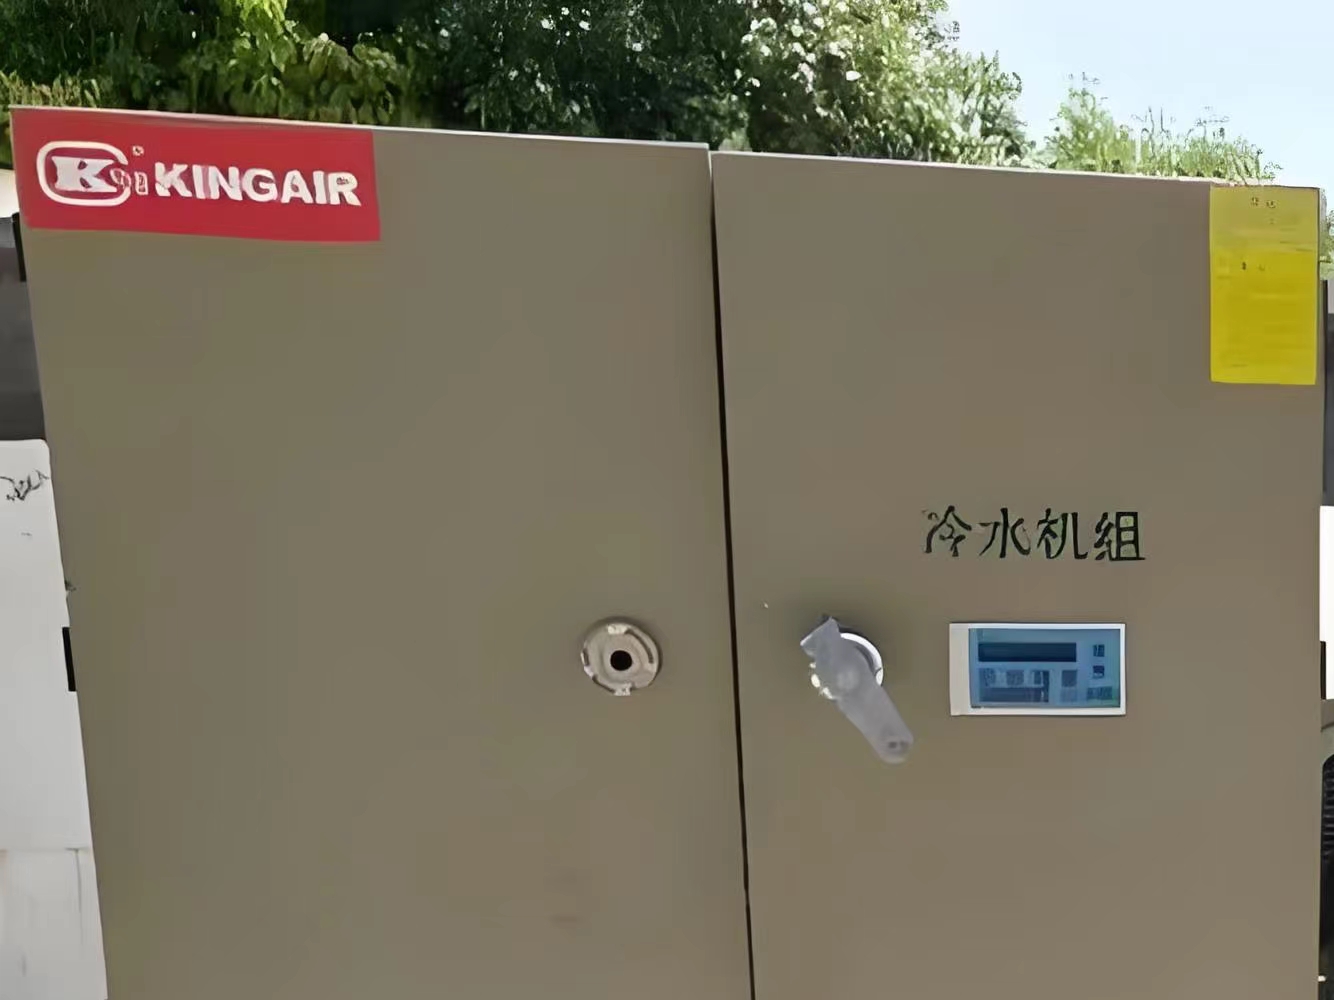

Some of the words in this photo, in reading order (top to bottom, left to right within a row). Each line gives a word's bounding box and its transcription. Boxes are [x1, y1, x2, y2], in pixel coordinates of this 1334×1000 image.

[155, 161, 362, 207] KINGAIR
[921, 505, 1147, 562] 冷水机组
